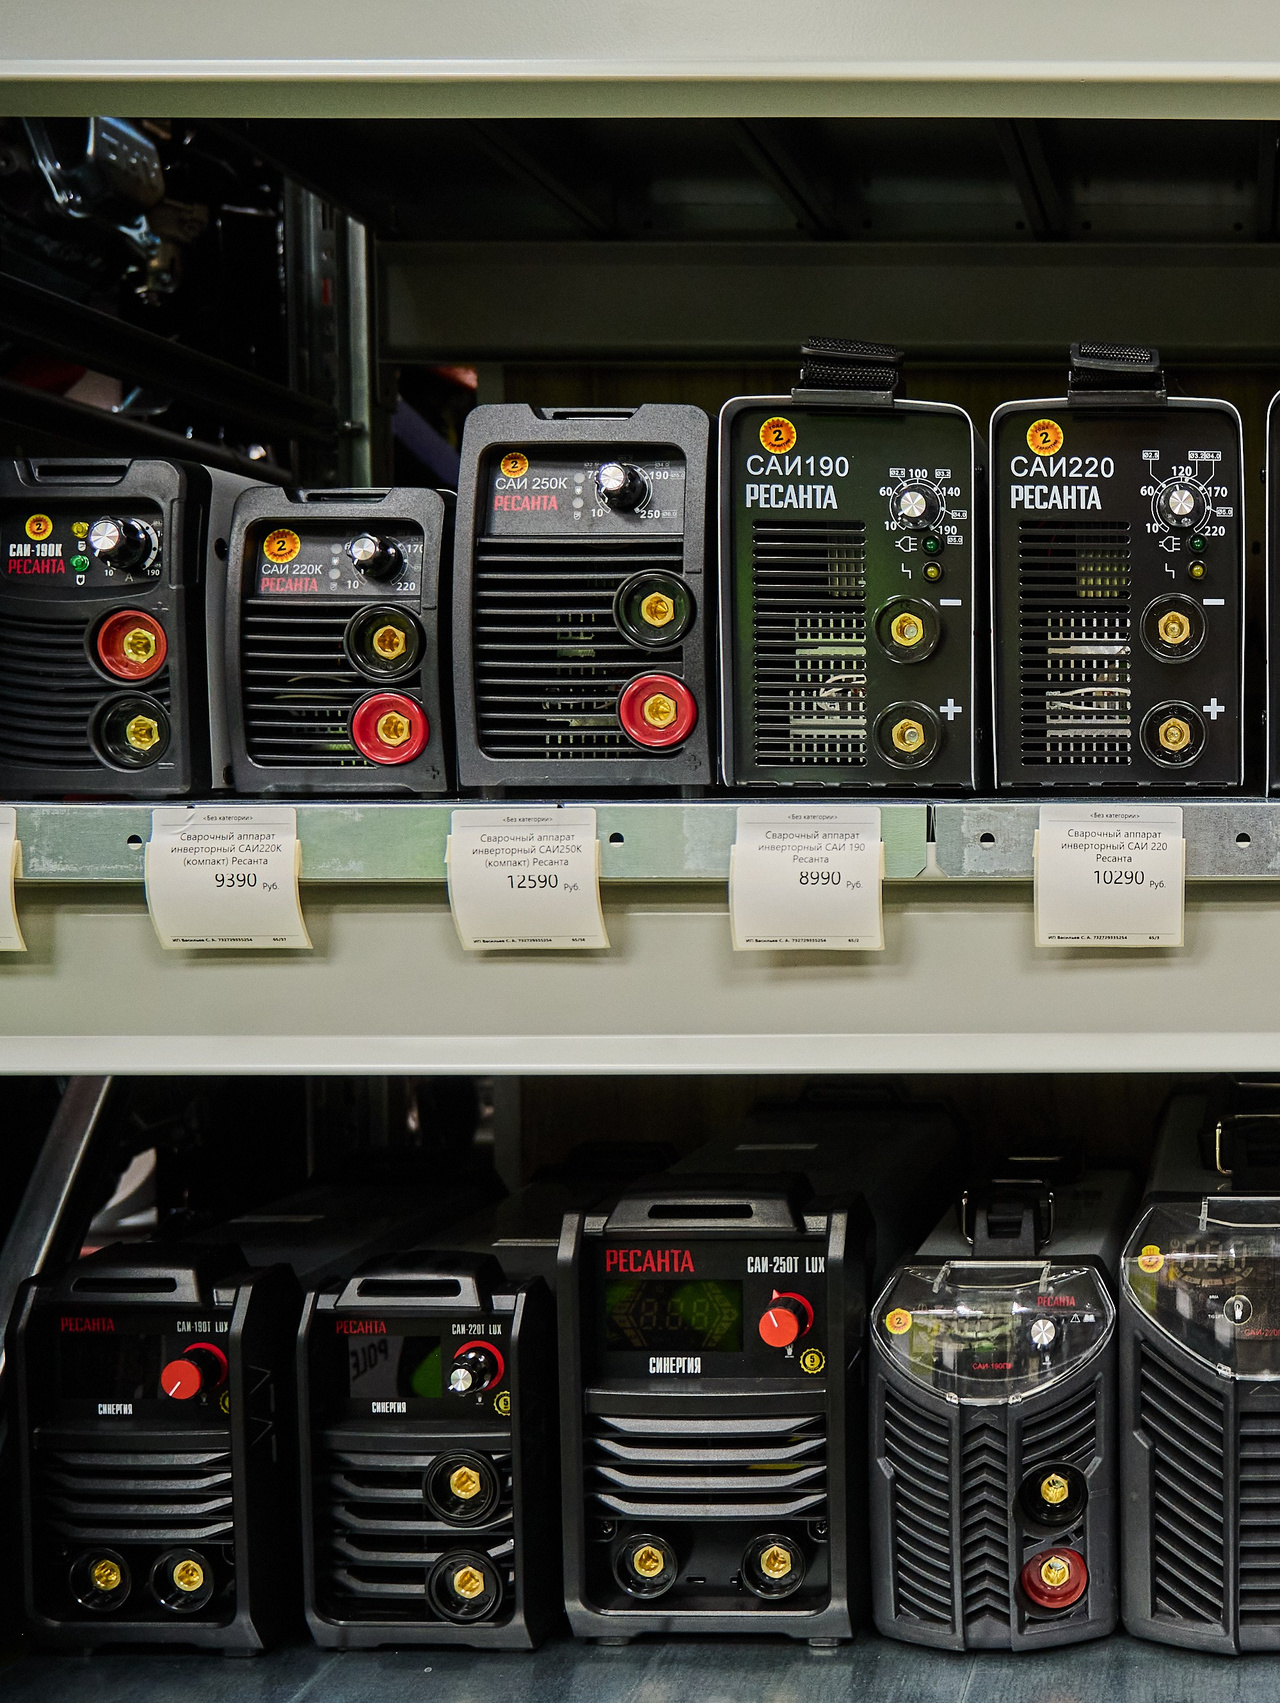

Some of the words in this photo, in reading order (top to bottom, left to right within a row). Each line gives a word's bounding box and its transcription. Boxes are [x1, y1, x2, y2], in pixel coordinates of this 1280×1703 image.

[772, 429, 783, 441] 2
[1040, 431, 1051, 444] 2
[511, 460, 518, 469] 2
[746, 454, 850, 478] САИ190
[1010, 455, 1115, 478] САИ220
[650, 471, 669, 480] 190
[908, 468, 928, 479] 100
[1171, 465, 1192, 476] 120
[495, 477, 527, 490] САИ
[532, 477, 567, 490] 250К
[745, 483, 838, 510] РЕСАНТА
[879, 487, 893, 497] 60
[942, 487, 961, 497] 140
[1140, 485, 1154, 497] 60
[1208, 486, 1228, 497] 170
[1010, 484, 1102, 510] РЕСАНТА
[494, 495, 558, 511] РЕСАНТА
[591, 508, 603, 517] 10
[640, 509, 660, 519] 250
[36, 522, 42, 531] 2
[884, 520, 897, 531] 10
[939, 525, 957, 535] 190
[1145, 523, 1159, 533] 10
[1205, 526, 1226, 536] 220
[9, 543, 62, 557] САИ-190К
[276, 540, 286, 552] 2
[8, 559, 65, 575] РЕСАНТА
[262, 564, 289, 575] САИ
[293, 564, 323, 575] 220К
[147, 569, 160, 577] 190
[261, 577, 319, 592] РЕСАНТА
[347, 579, 359, 589] 10
[396, 582, 415, 591] 220
[180, 832, 234, 842] Сварочный
[236, 833, 276, 842] аппарат
[480, 832, 535, 843] Сварочный
[537, 833, 576, 842] аппарат
[765, 830, 819, 841] Сварочный
[822, 832, 860, 841] аппарат
[1067, 829, 1121, 839] Сварочный
[1124, 830, 1162, 840] аппарат
[170, 844, 236, 854] инверторный
[238, 844, 282, 854] САИ220К
[472, 845, 536, 856] инверторный
[538, 844, 583, 854] САИ250К
[758, 843, 822, 853] инверторный
[825, 843, 846, 852] САИ
[849, 843, 866, 852] 190
[1061, 842, 1125, 852] инверторный
[1127, 842, 1148, 851] САИ
[1150, 842, 1168, 851] 220
[183, 857, 229, 867] (компакт)
[231, 856, 269, 866] Ресанта
[484, 858, 530, 868] (компакт)
[532, 857, 569, 867] Ресанта
[792, 854, 829, 864] Ресанта
[1096, 854, 1132, 863] Ресанта
[215, 873, 257, 888] 9390
[262, 883, 280, 892] Руб.
[507, 874, 558, 889] 12590
[563, 883, 580, 893] Руб.
[799, 871, 841, 886] 8990
[846, 880, 863, 890] Руб.
[1094, 870, 1145, 885] 10290
[1149, 880, 1166, 889] Руб.
[605, 1249, 695, 1273] РЕСАНТА
[805, 1256, 825, 1274] LUX
[1037, 1295, 1076, 1307] РЕСАНТА
[60, 1316, 115, 1333] РЕСАНТА
[215, 1321, 229, 1333] LUX
[336, 1320, 387, 1334] РЕСАНТА
[489, 1324, 502, 1335] LUX
[649, 1356, 702, 1374] СИНЕРГИЯ
[97, 1403, 133, 1415] СИНЕРГИЯ
[371, 1401, 407, 1413] СИНЕРГИЯ
